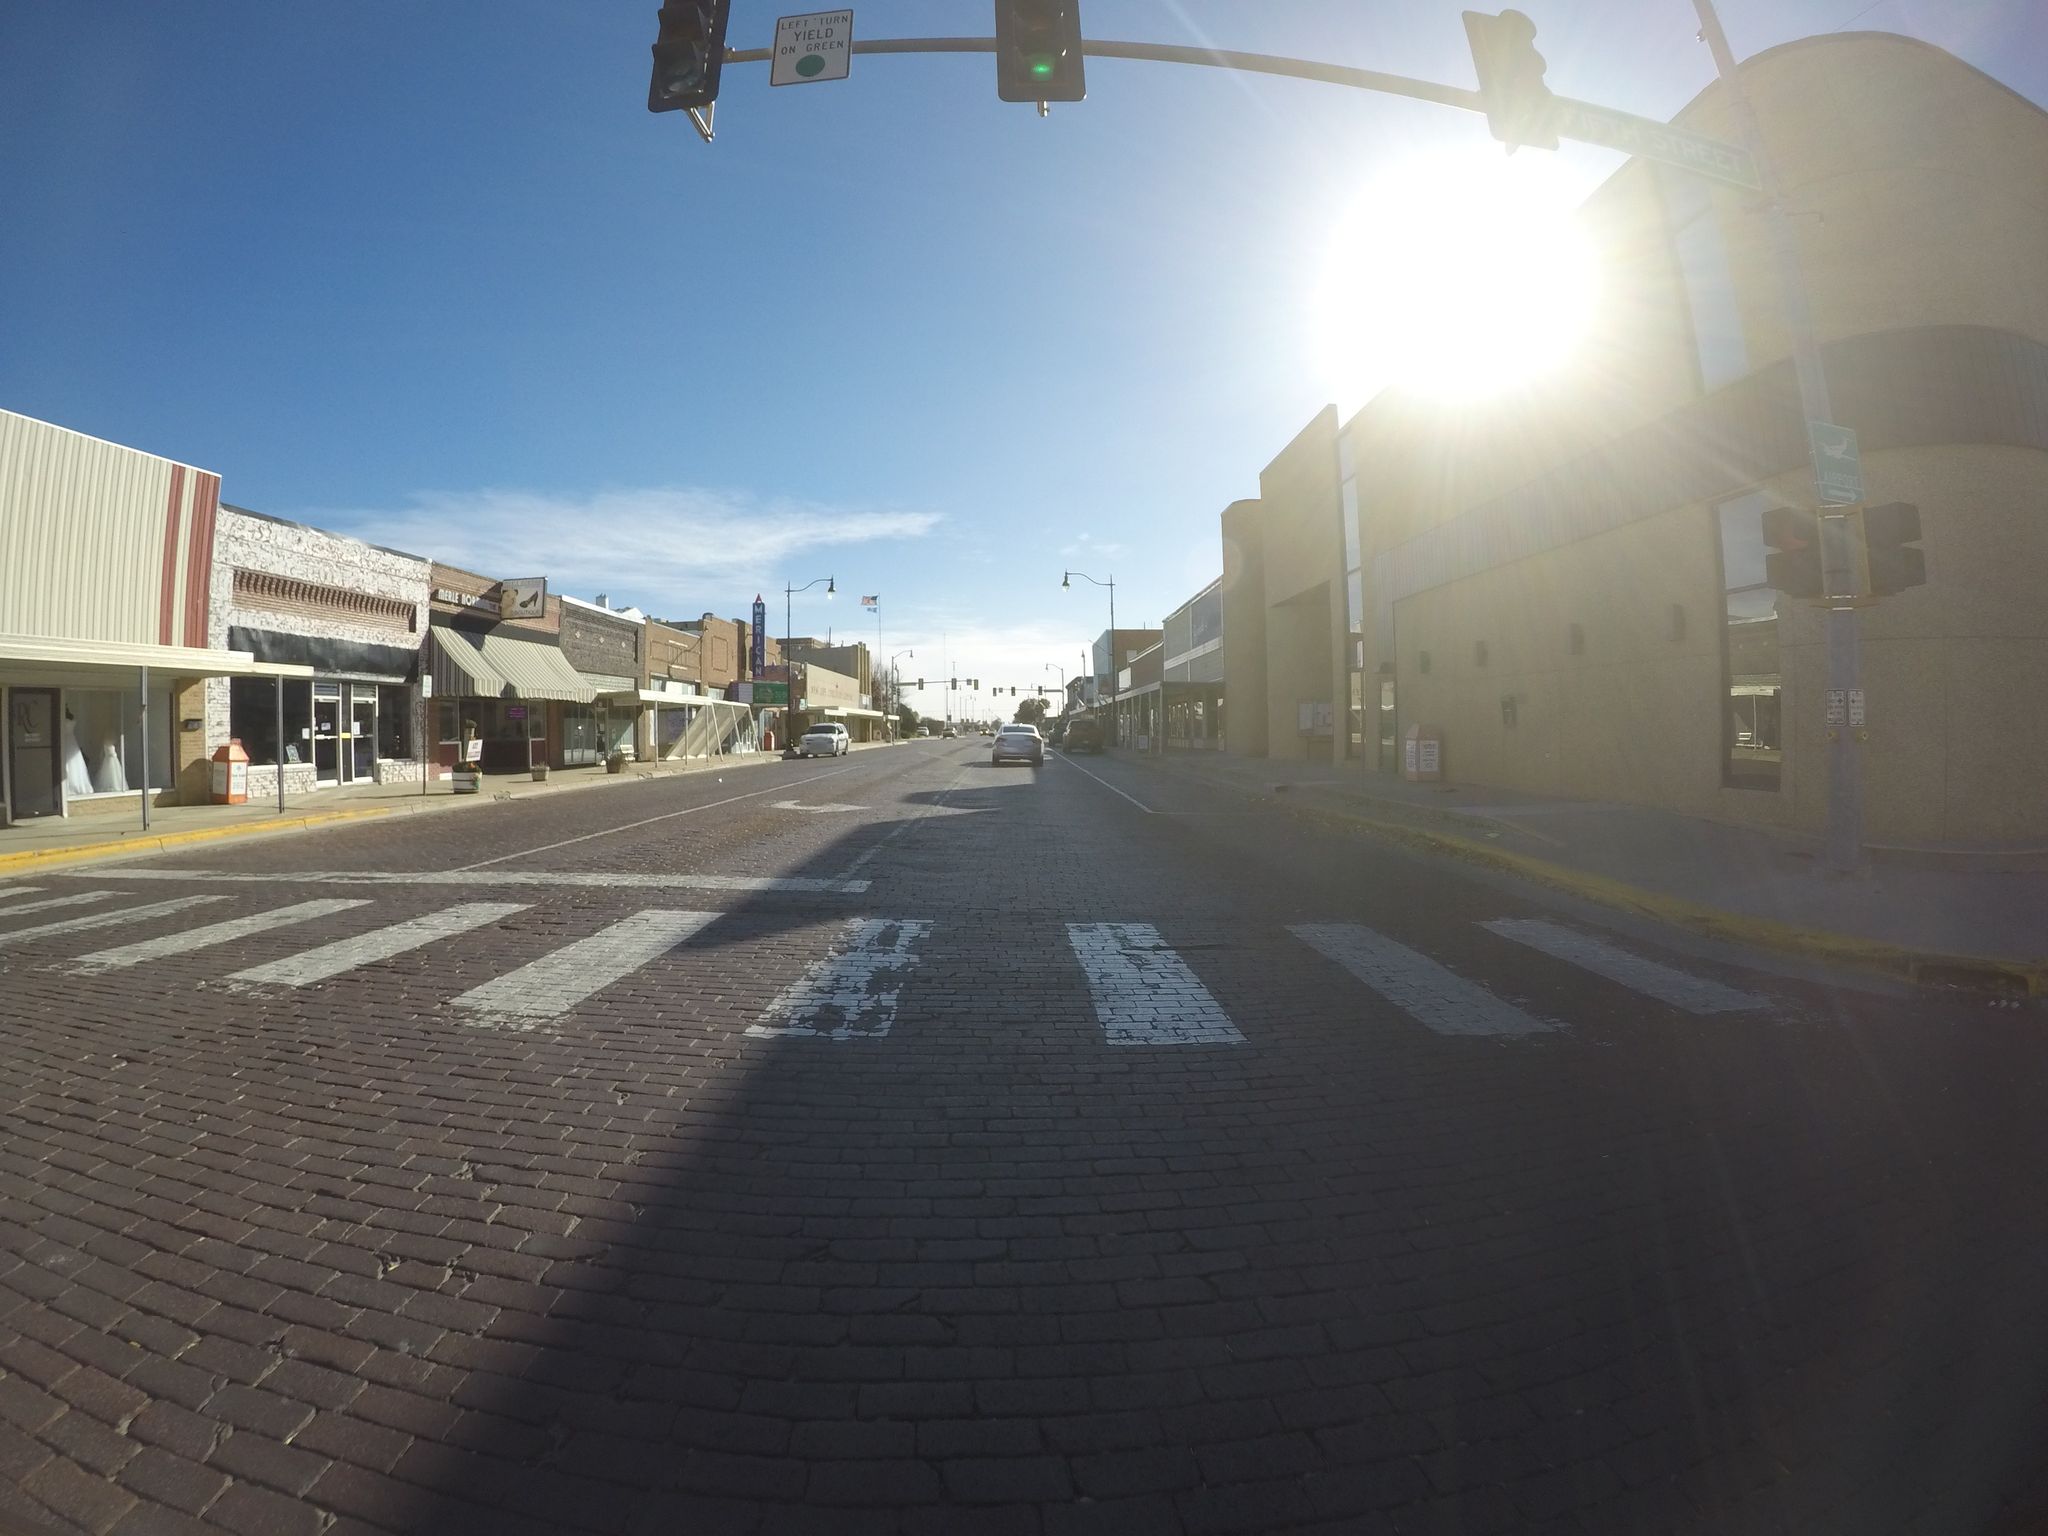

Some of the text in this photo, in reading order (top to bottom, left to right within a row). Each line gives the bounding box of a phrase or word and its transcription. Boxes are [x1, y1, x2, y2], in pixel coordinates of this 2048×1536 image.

[781, 15, 849, 31] LEFT TURN
[794, 28, 834, 42] YIELD
[781, 40, 844, 55] ON GREEN
[1653, 131, 1741, 173] STREET
[1823, 471, 1860, 489] AIRPORT
[438, 588, 459, 604] MERLE
